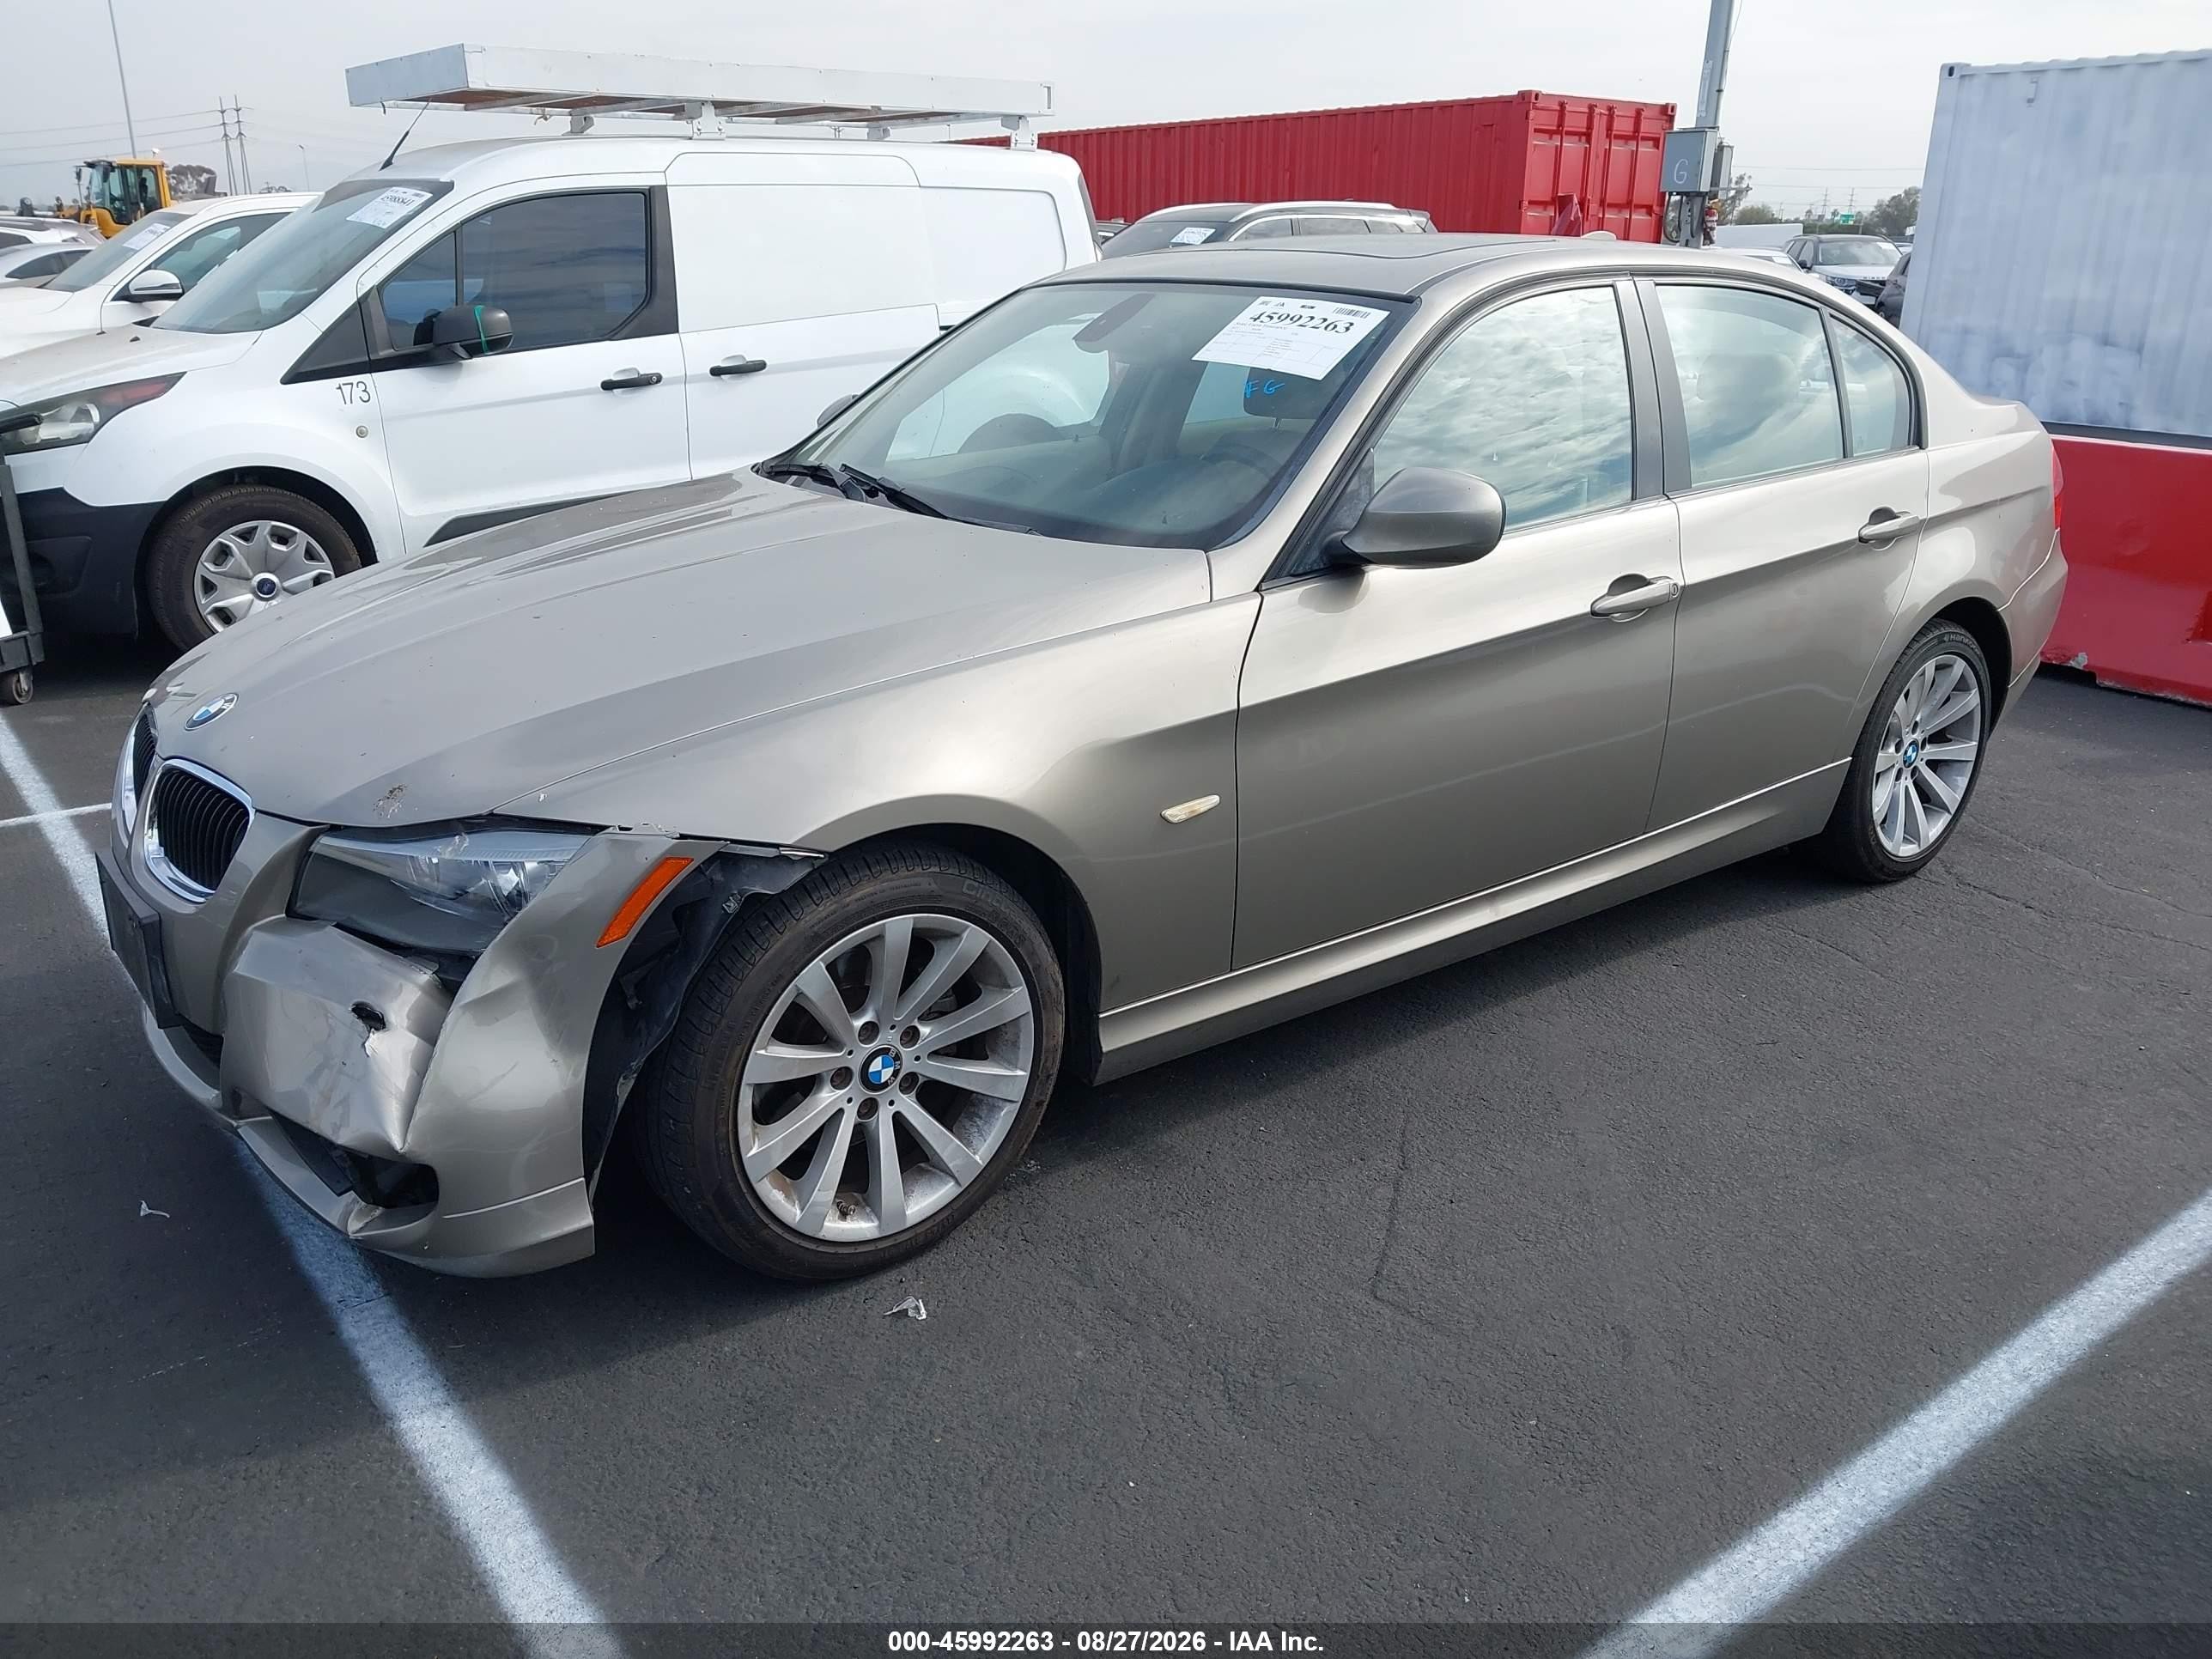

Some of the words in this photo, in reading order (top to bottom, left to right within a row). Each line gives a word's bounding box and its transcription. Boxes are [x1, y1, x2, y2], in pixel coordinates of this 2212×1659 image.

[1674, 158, 1689, 185] G
[1249, 310, 1355, 334] 45992263
[335, 380, 371, 405] 173
